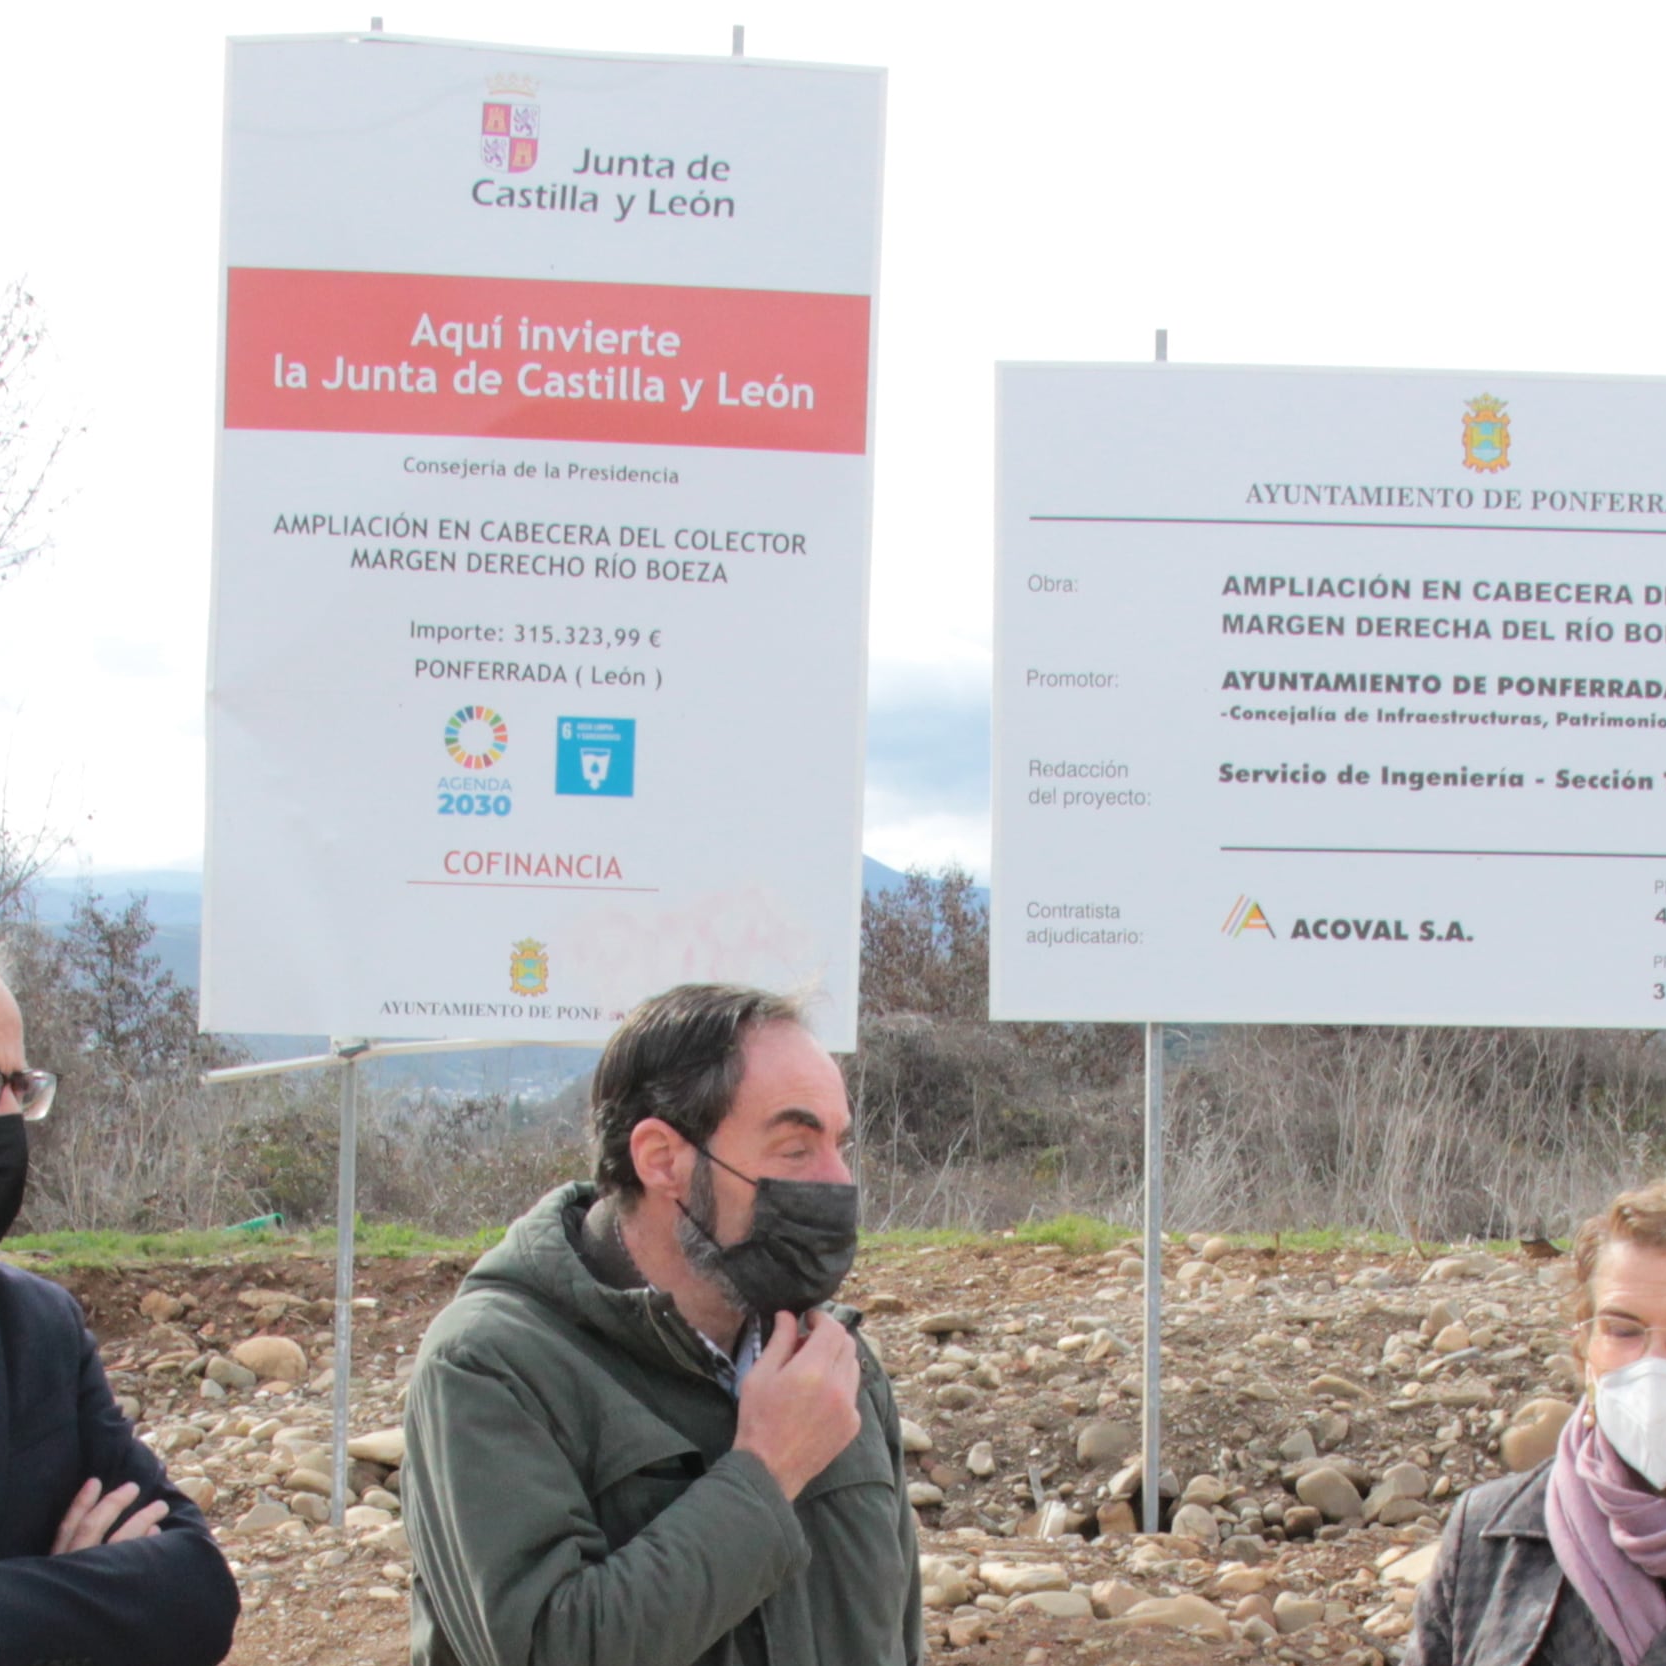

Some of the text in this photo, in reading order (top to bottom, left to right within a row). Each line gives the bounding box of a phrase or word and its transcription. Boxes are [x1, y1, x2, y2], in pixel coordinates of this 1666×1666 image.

[573, 148, 730, 182] Junta de
[472, 179, 734, 223] Castilla y León
[411, 313, 681, 358] Aquí invierte
[274, 353, 815, 412] la Junta de Castilla y León
[514, 461, 537, 478] de
[545, 462, 560, 479] la
[568, 463, 679, 484] Presidencia
[1246, 484, 1474, 508] AYUNTAMIENTO
[1484, 489, 1521, 509] DE
[274, 512, 806, 555] AMPLIACIÓN EN CABECERA DEL COLECTOR
[351, 548, 728, 583] MARGEN DERECHO RÍO BOEZA
[1027, 574, 1077, 592] Obra:
[1222, 574, 1410, 599] AMPLIACIÓN
[1423, 580, 1461, 600] EN
[1473, 581, 1633, 605] CABECERA
[411, 620, 661, 649] Importe: 315.323,99 €
[1223, 614, 1344, 636] MARGEN
[1356, 617, 1491, 639] DERECHA
[1502, 620, 1555, 641] DEL
[1566, 617, 1614, 642] RÍO
[415, 659, 567, 683] PONFERRADA
[592, 666, 645, 686] León
[1027, 669, 1118, 688] Promotor:
[1221, 671, 1441, 694] AYUNTAMIENTO
[1453, 675, 1486, 695] DE
[1344, 707, 1369, 723] de
[1377, 707, 1548, 728] Infraestructuras,
[561, 722, 572, 740] 6
[1029, 760, 1128, 778] Redacción
[1219, 763, 1326, 784] Servicio
[1337, 764, 1370, 785] de
[1381, 766, 1524, 791] Ingeniería
[1556, 769, 1653, 790] Sección
[437, 776, 512, 792] AGENDA
[438, 793, 512, 817] 2030
[1029, 787, 1151, 810] del proyecto:
[444, 850, 622, 880] COFINANCIA
[1027, 901, 1120, 919] Contratista
[1026, 927, 1143, 948] adjudicatario:
[1291, 919, 1473, 942] ACOVAL S.A.
[381, 1001, 523, 1017] AYUNTAMIENTO
[529, 1005, 551, 1019] DE
